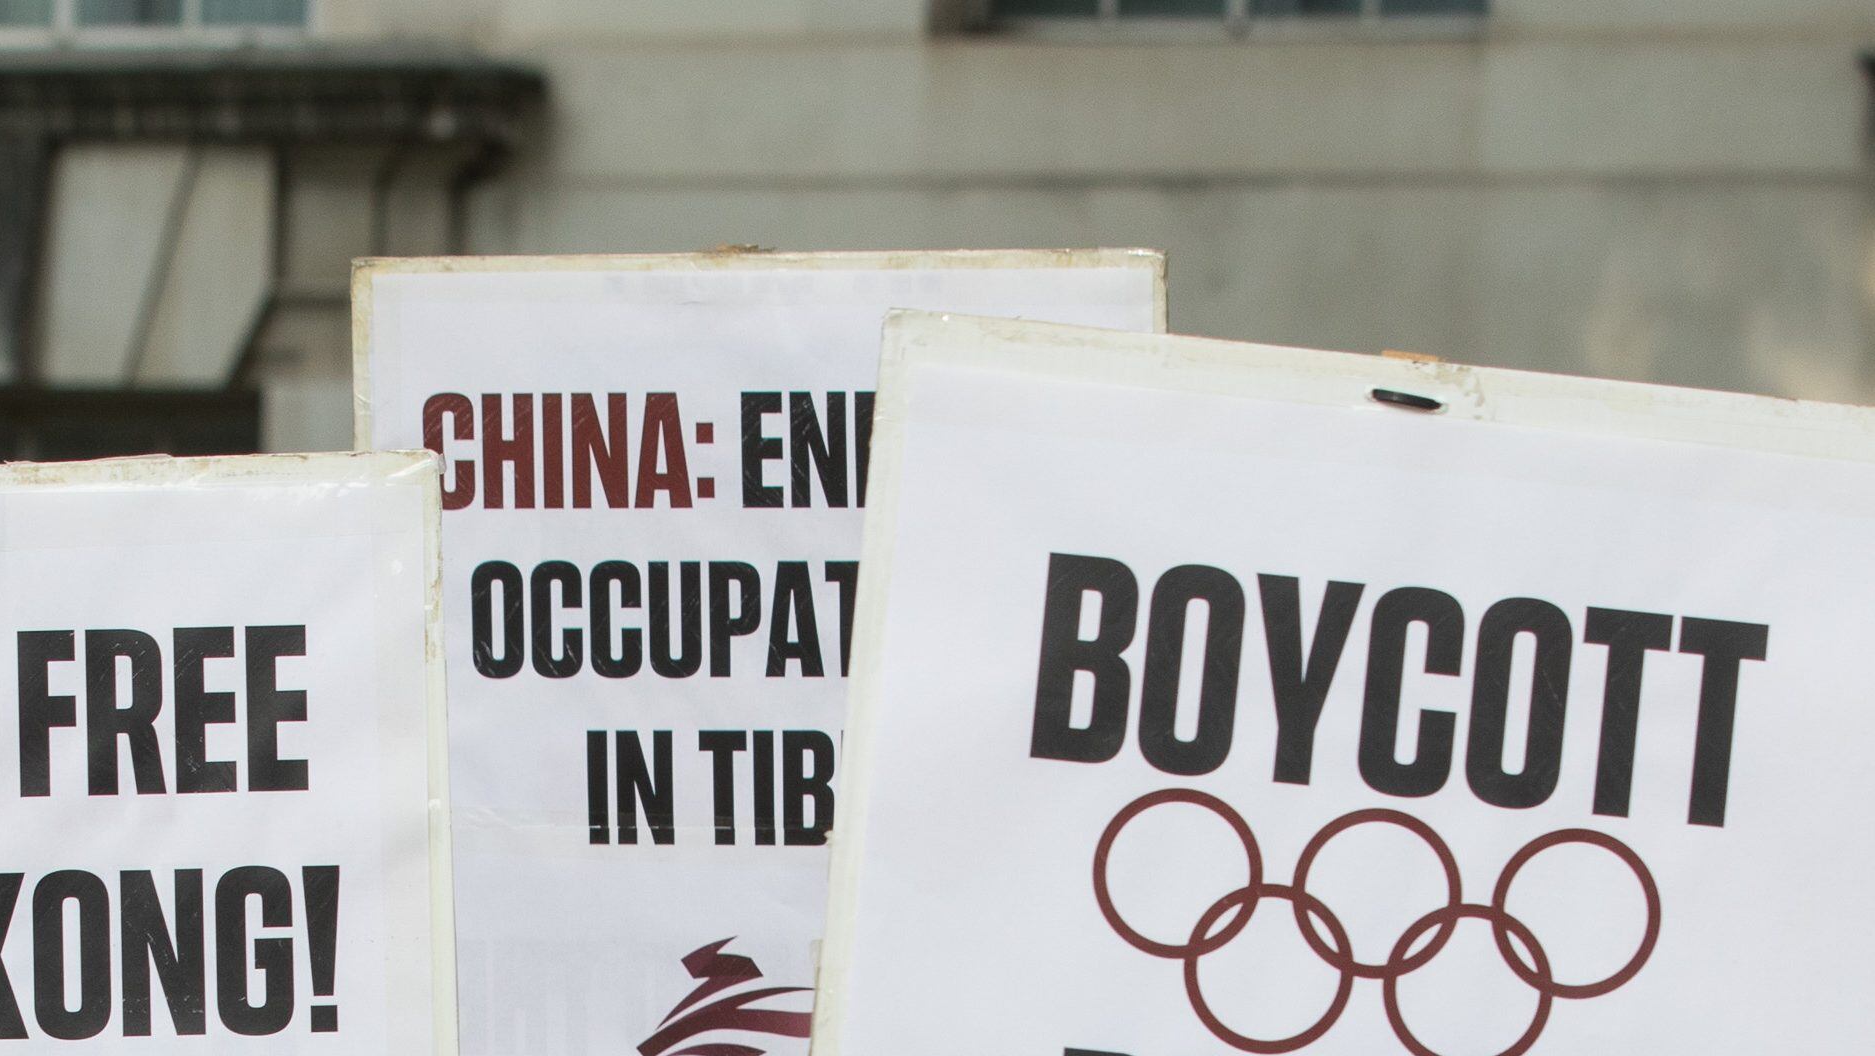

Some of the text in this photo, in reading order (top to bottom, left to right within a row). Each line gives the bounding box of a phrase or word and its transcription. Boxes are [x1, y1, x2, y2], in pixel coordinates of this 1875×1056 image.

[423, 393, 716, 510] CHINA:
[471, 560, 859, 679] OCCUPAT
[17, 625, 308, 797] FREE
[1030, 552, 1769, 828] BOYCOTT
[586, 730, 843, 846] IN TIB
